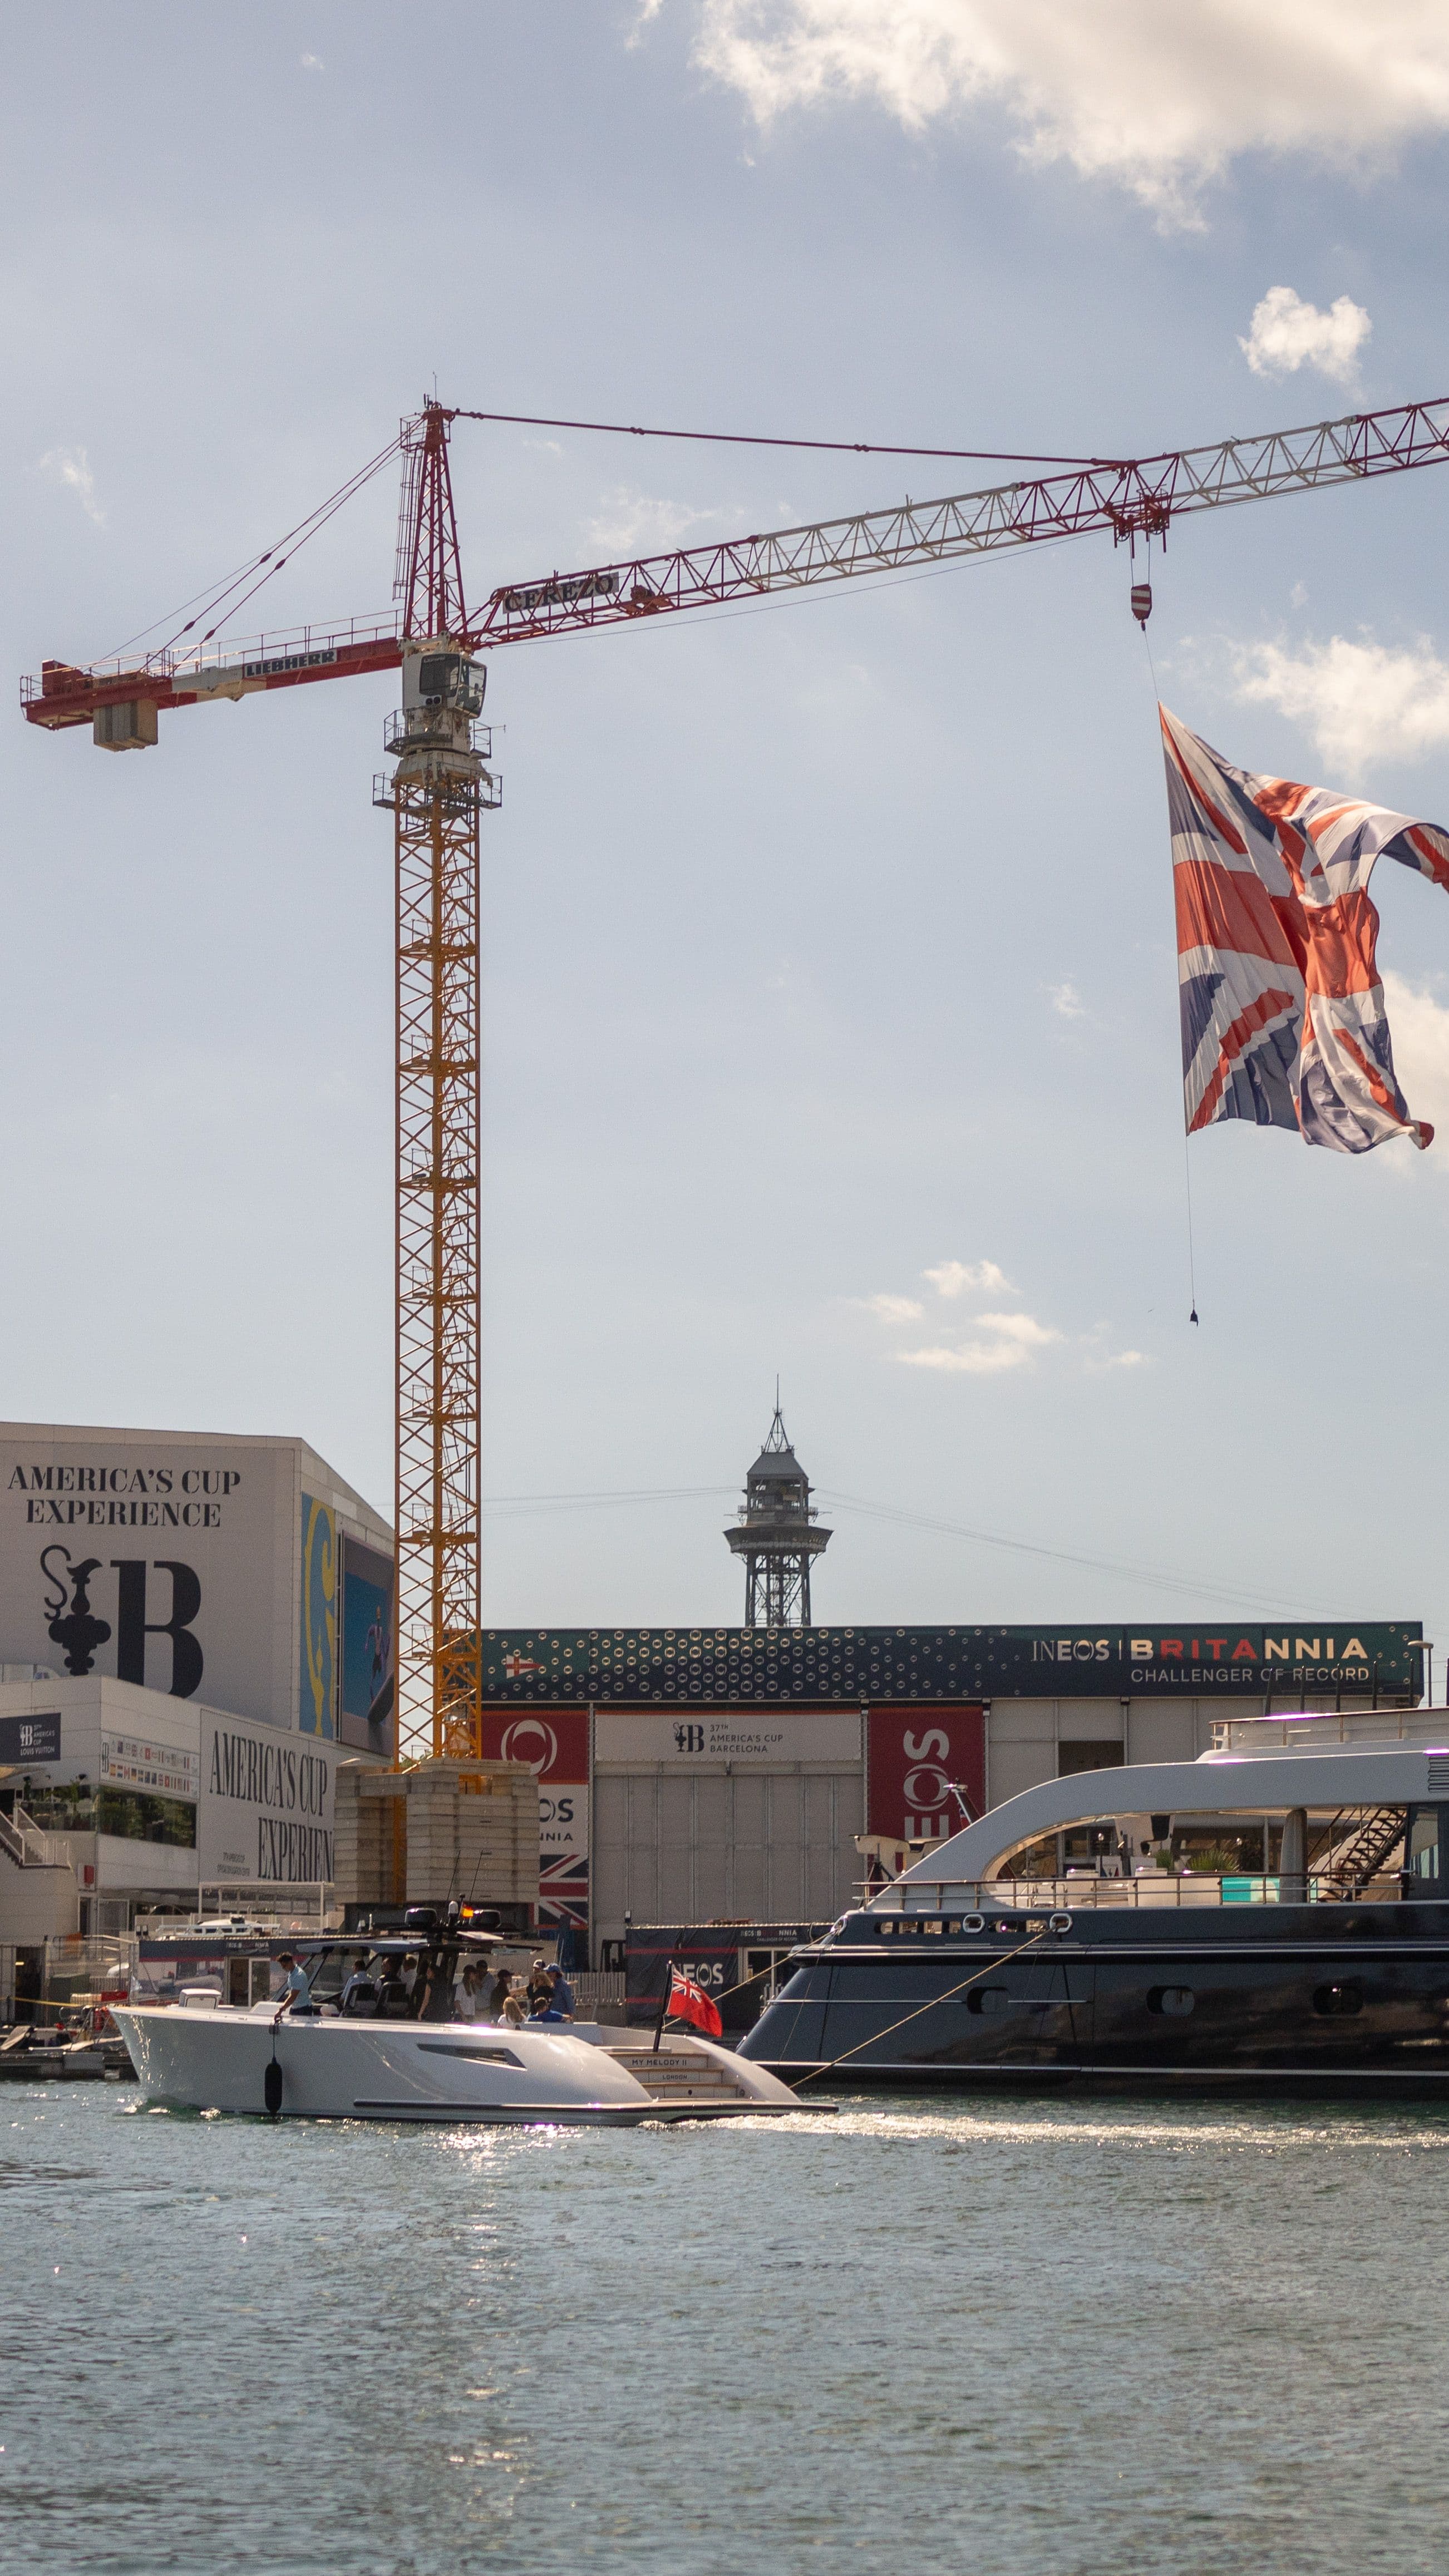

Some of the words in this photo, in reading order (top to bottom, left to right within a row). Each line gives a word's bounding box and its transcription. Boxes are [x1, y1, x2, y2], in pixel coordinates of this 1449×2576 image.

[505, 575, 613, 611] CEREZO
[247, 651, 334, 677] LIEBHERR
[7, 1465, 173, 1493] AMERICA'S
[181, 1469, 240, 1495] CUP
[26, 1499, 221, 1527] EXPERIENCE
[1031, 1639, 1110, 1661] INEOS
[1131, 1638, 1368, 1661] BRITANNIA
[1131, 1669, 1253, 1682] CHALLENGER
[1260, 1668, 1284, 1682] OF
[1293, 1667, 1369, 1681] RECORD
[20, 1748, 34, 1756] LOUIS
[209, 1730, 296, 1810] AMERICA'S
[299, 1753, 328, 1817] CUP
[903, 1728, 950, 1840] EOS
[539, 1798, 574, 1823] OS
[258, 1817, 334, 1882] EXPERIEN
